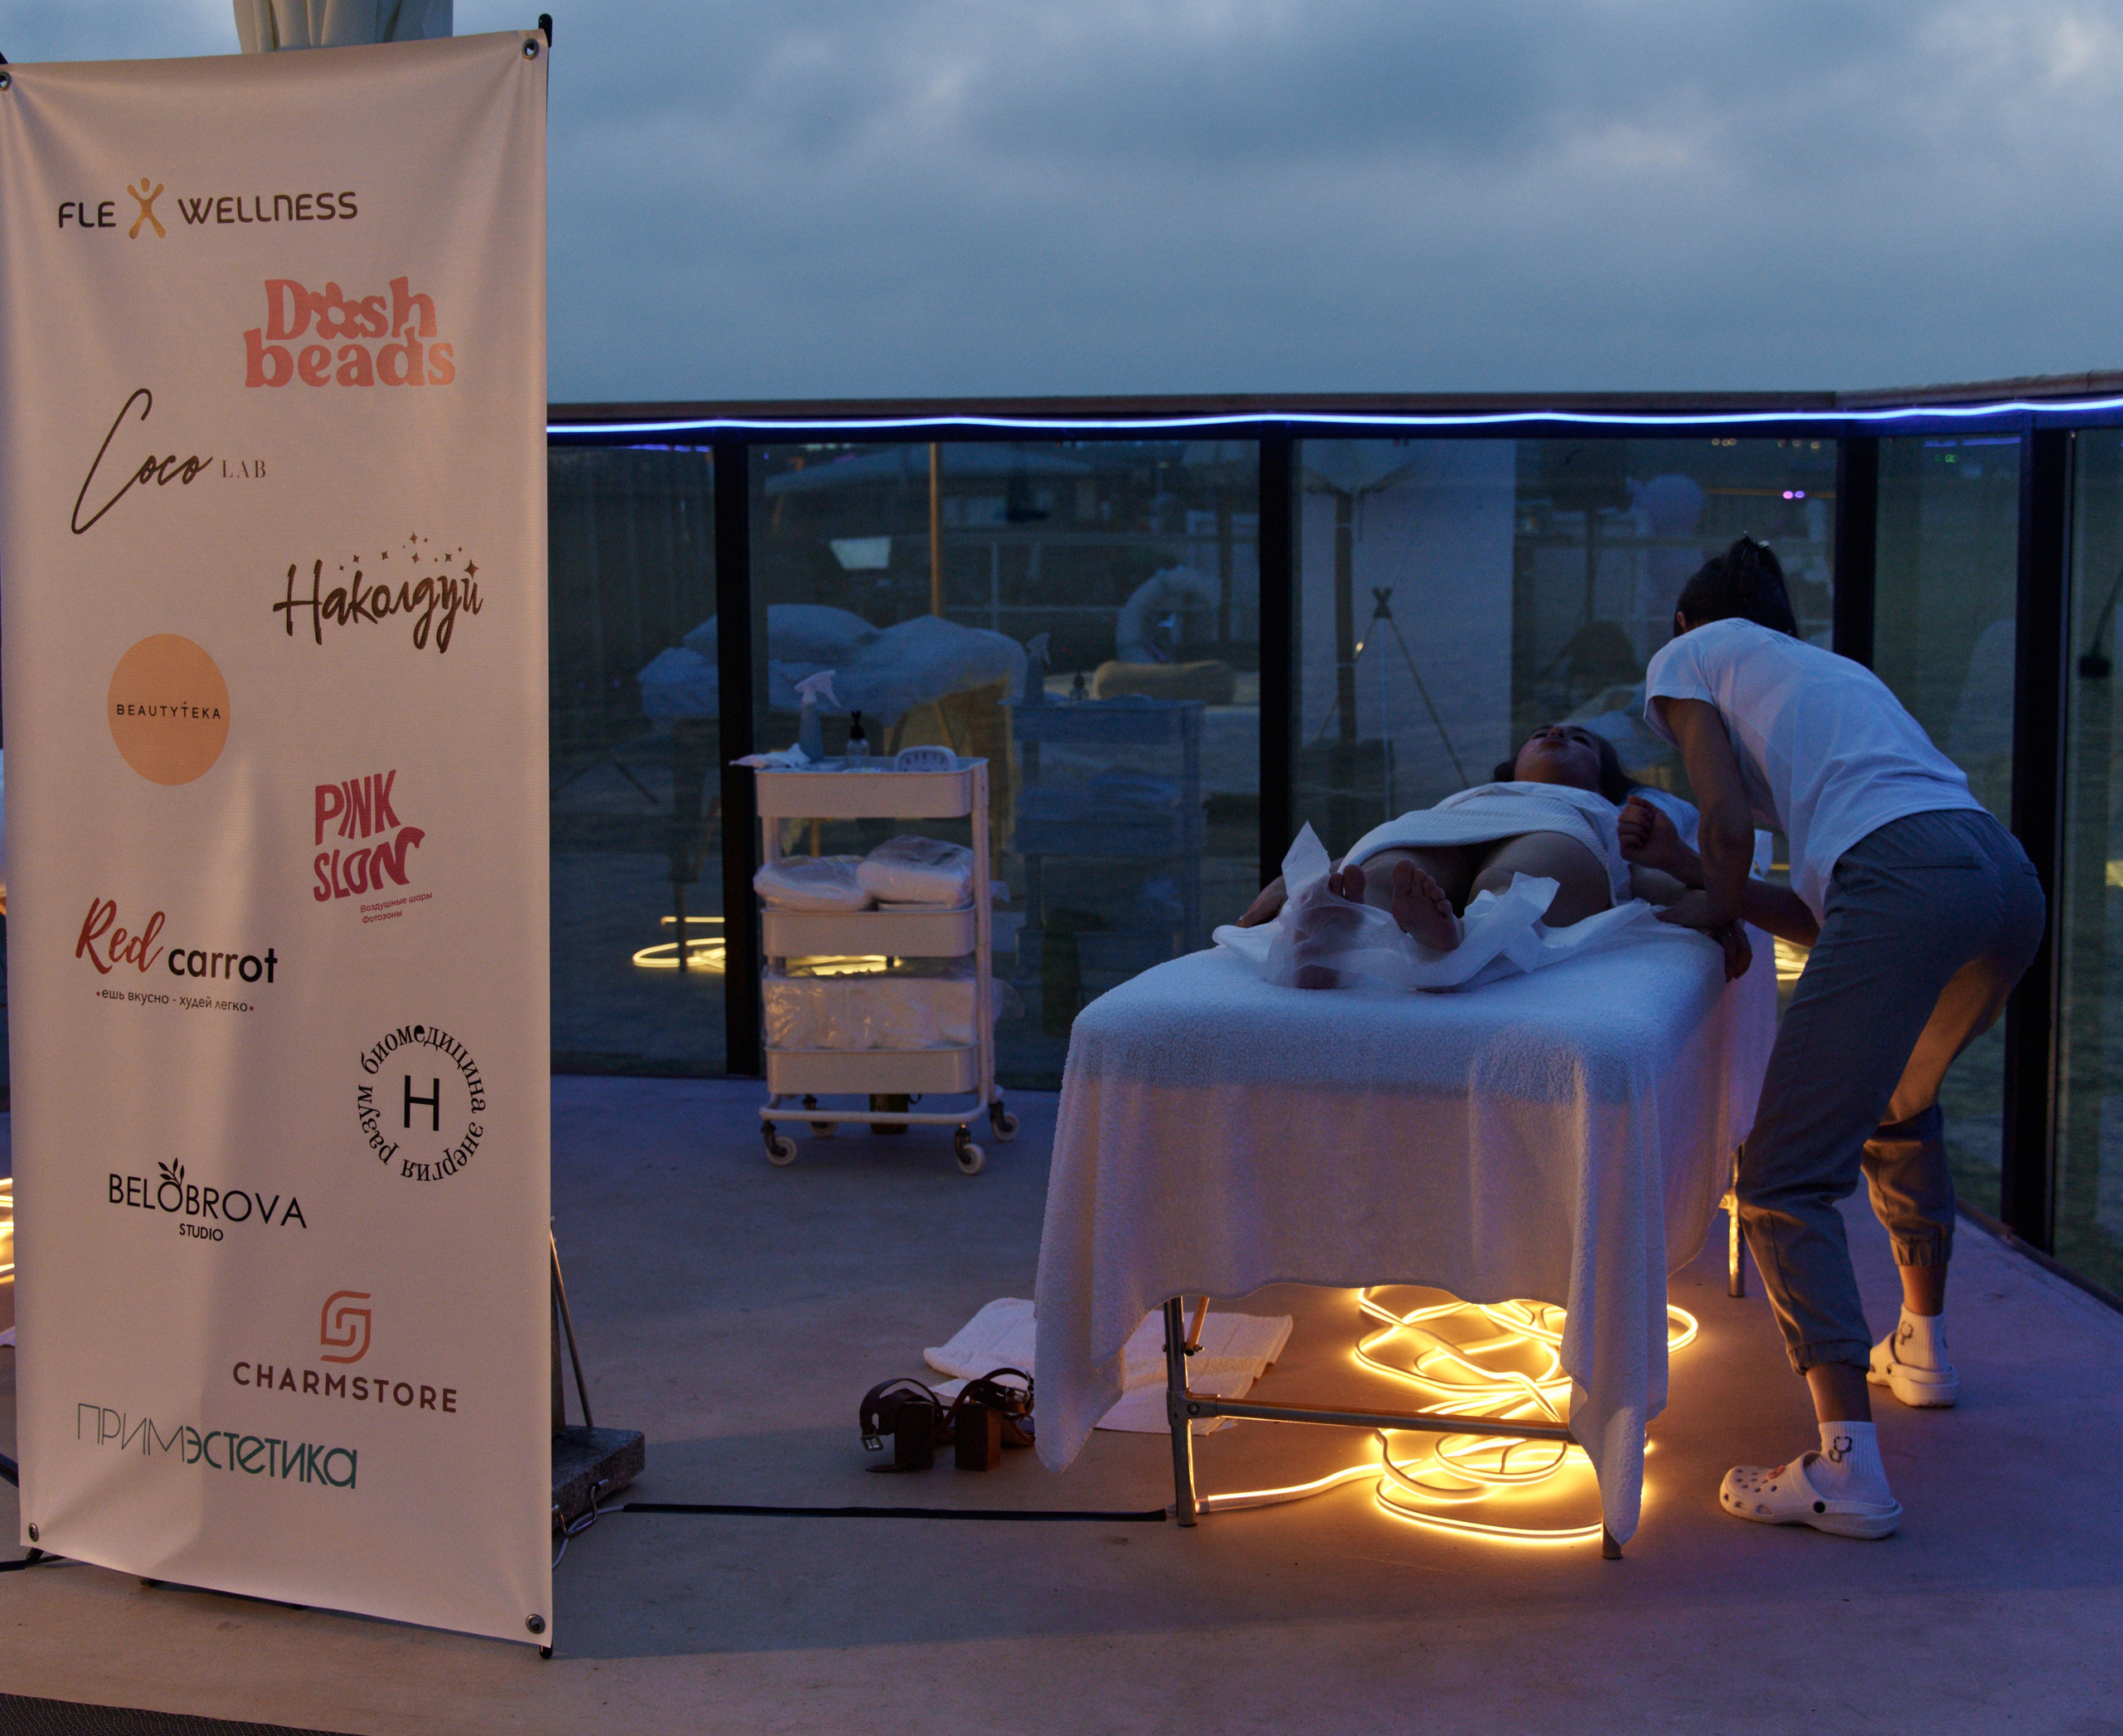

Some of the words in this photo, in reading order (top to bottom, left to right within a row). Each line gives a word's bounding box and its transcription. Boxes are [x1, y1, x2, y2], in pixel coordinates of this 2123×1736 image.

[177, 192, 358, 225] WELLNESS
[243, 326, 455, 388] beads
[71, 388, 214, 535] Coco
[221, 460, 267, 479] LAB
[273, 559, 483, 654] Наколдуй
[314, 770, 401, 846] PINK
[313, 826, 425, 902] SLON
[360, 897, 407, 912] Воздушные
[409, 892, 433, 903] шары
[362, 911, 403, 924] Фотозоны
[75, 897, 166, 975] Red
[168, 948, 278, 983] carrot
[128, 991, 169, 1006] вкусно
[179, 996, 212, 1010] худей
[215, 1001, 248, 1012] легко
[361, 1024, 486, 1115] биомедицина
[357, 1084, 400, 1165] разум
[400, 1121, 484, 1182] энергия
[109, 1172, 307, 1228] BELOBROVA
[178, 1223, 224, 1242] STUDIO
[232, 1362, 457, 1413] CHARMSTORE
